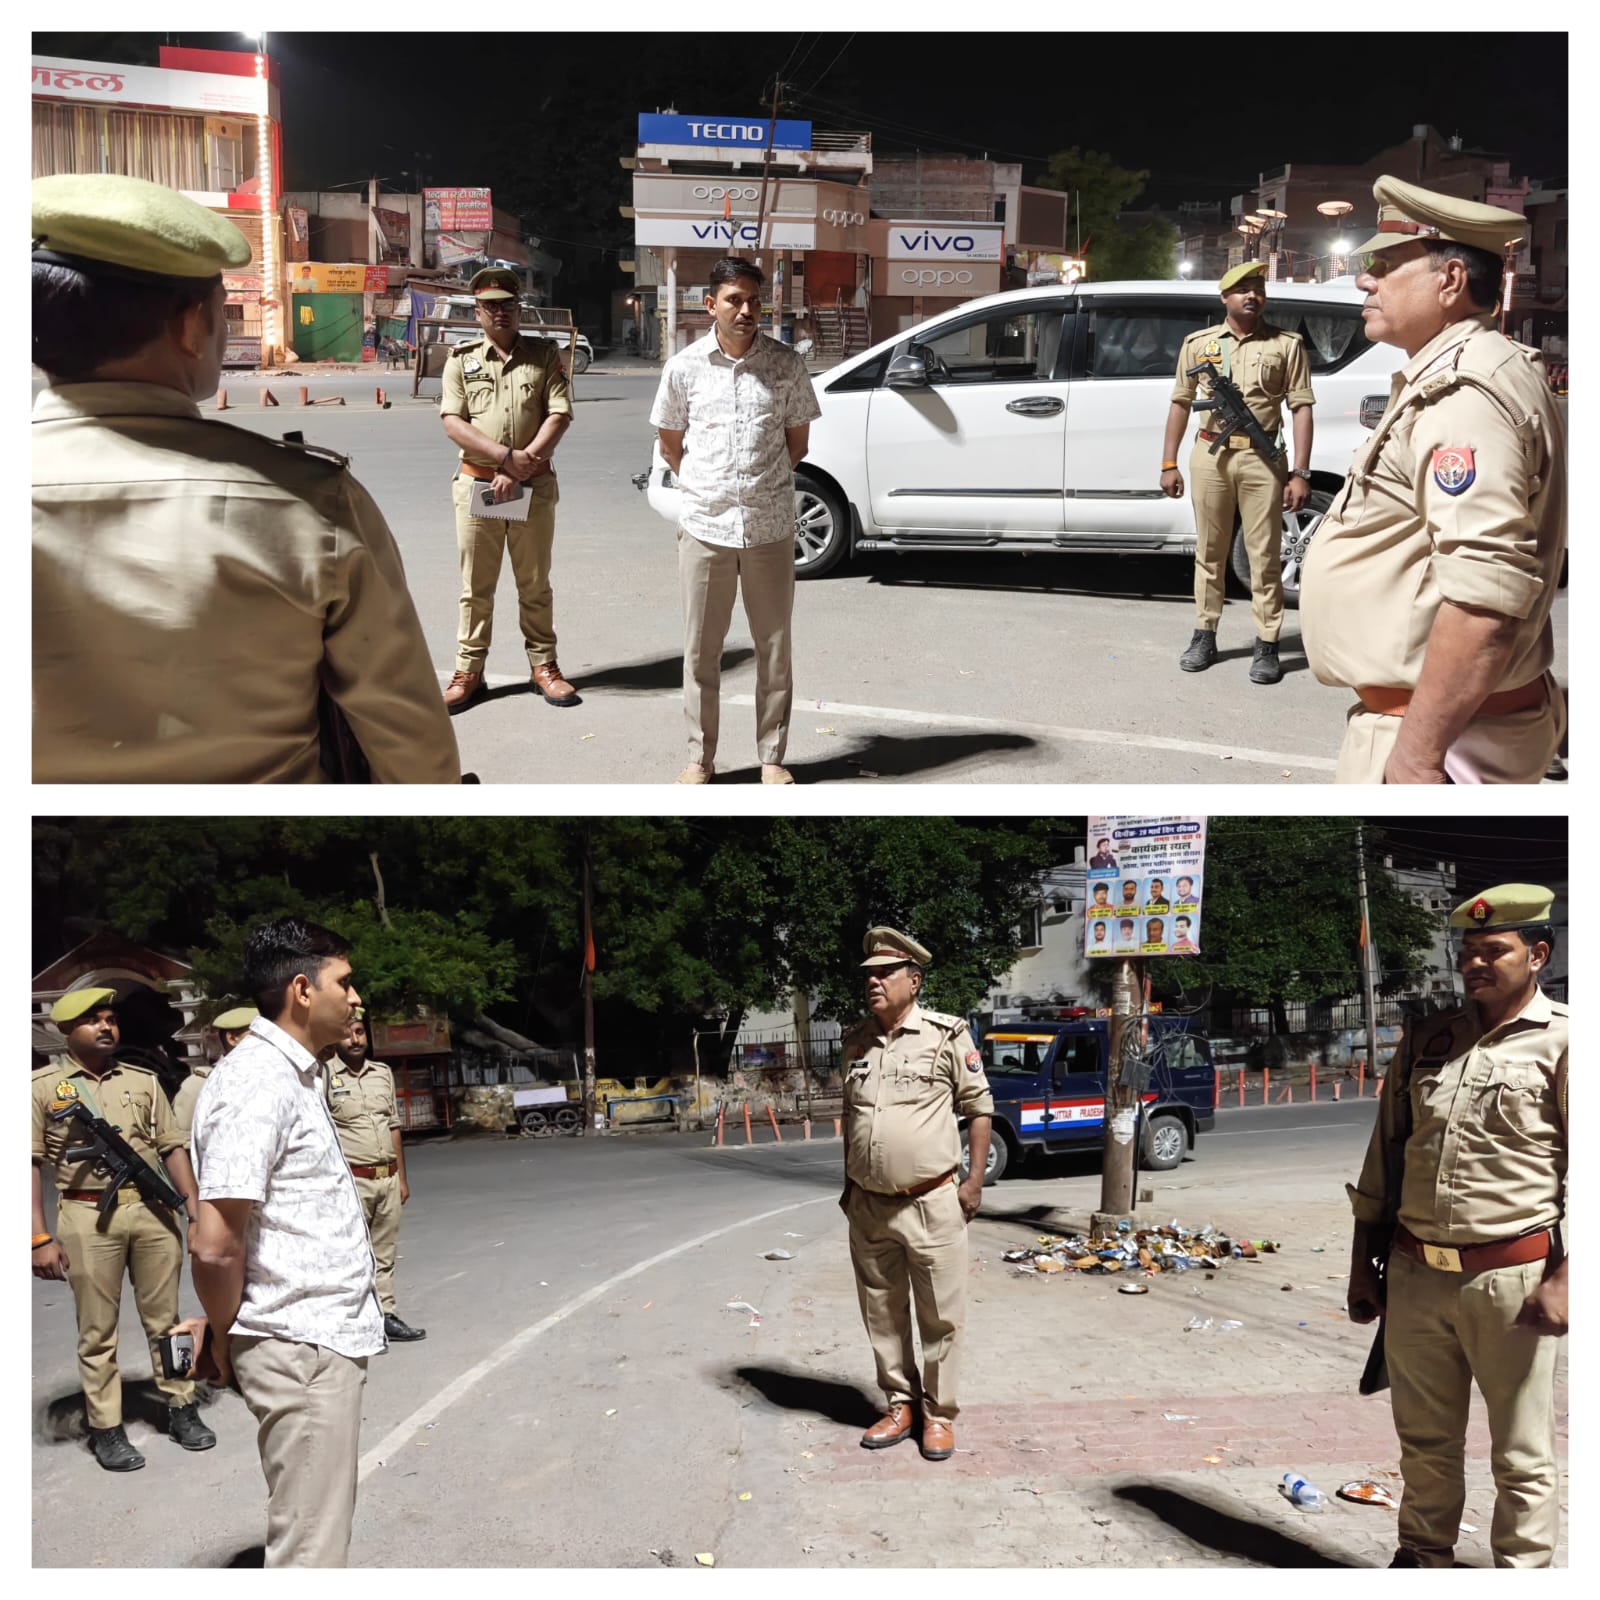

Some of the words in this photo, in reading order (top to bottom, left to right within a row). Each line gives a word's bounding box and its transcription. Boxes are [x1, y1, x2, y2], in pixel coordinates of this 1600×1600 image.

[687, 122, 763, 141] TECNO
[823, 209, 865, 227] oppo
[692, 221, 759, 241] vivo
[900, 230, 975, 252] vivo
[902, 269, 974, 288] oppo
[1054, 1109, 1072, 1120] UTTAR
[1080, 1107, 1104, 1118] PRADESH
